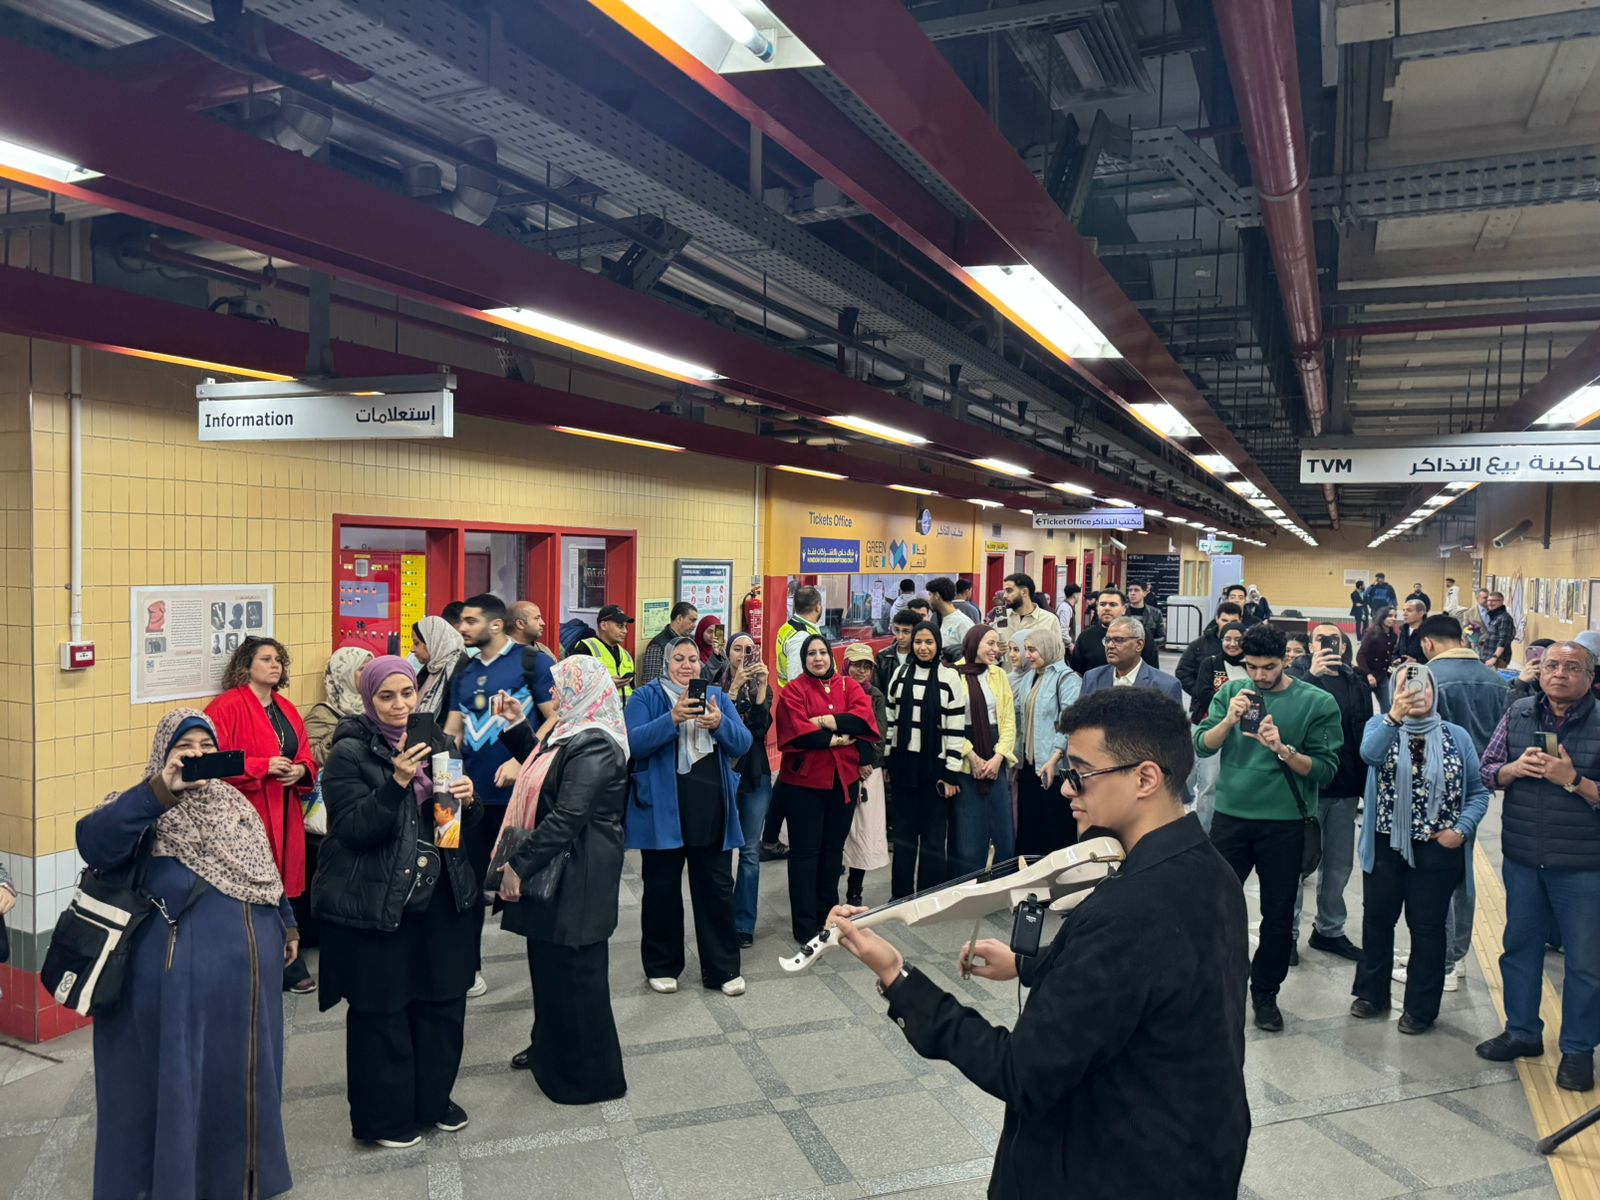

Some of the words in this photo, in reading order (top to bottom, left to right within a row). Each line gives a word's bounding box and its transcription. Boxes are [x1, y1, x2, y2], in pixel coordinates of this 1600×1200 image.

[204, 410, 294, 428] Information
[355, 405, 436, 425] إستعلامات
[1306, 458, 1353, 473] TVM
[1409, 457, 1481, 476] التذاكر
[1485, 456, 1521, 475] بيع
[1528, 454, 1600, 475] اكينة
[809, 511, 833, 526] Tickets
[833, 514, 853, 528] Office
[1042, 518, 1067, 526] Ticket
[1067, 518, 1092, 526] Office
[1092, 517, 1118, 527] التذاكر
[1119, 517, 1142, 527] مكتب
[866, 541, 887, 554] GREEN
[865, 555, 880, 568] LINE
